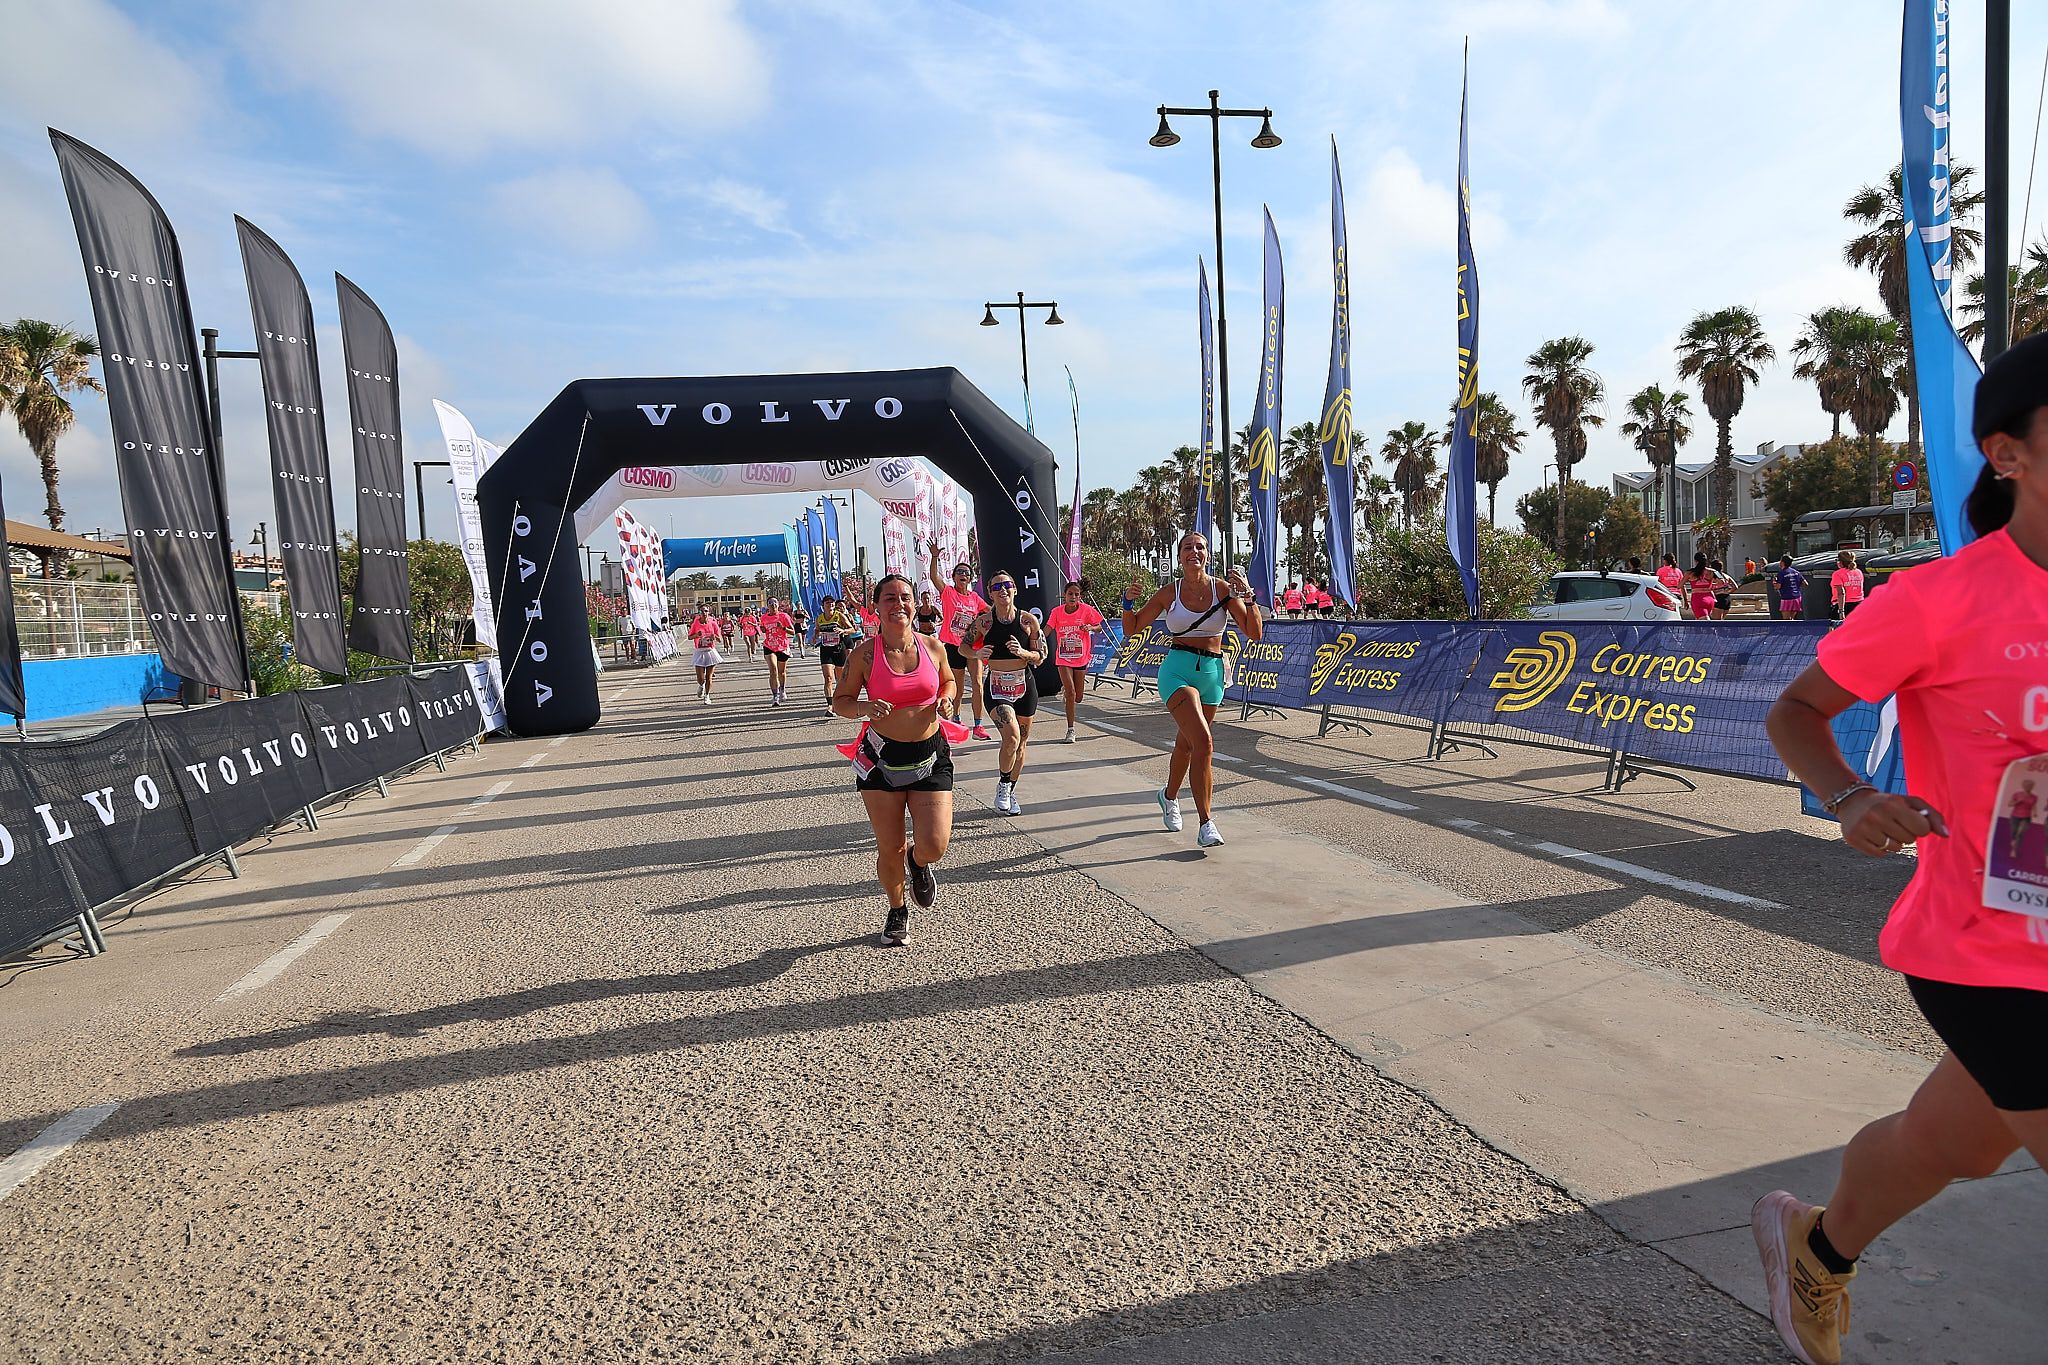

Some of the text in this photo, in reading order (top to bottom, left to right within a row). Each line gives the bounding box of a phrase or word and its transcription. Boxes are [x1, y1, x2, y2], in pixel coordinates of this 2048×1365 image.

[637, 396, 903, 426] VOLVO
[624, 467, 673, 489] COSMO
[746, 463, 791, 483] COSMO
[881, 459, 915, 482] COSM
[884, 501, 917, 518] COSM
[703, 539, 757, 562] Marlene
[514, 515, 553, 708] VOLVO
[1242, 638, 1284, 661] Correos
[1353, 639, 1421, 659] Correos
[1334, 663, 1402, 691] Express
[1591, 643, 1713, 684] Correos
[1237, 664, 1279, 692] Express
[420, 689, 473, 720] VOLVO
[1566, 681, 1697, 734] Express
[321, 706, 411, 749] VOLVO
[186, 732, 308, 794] VOLVO
